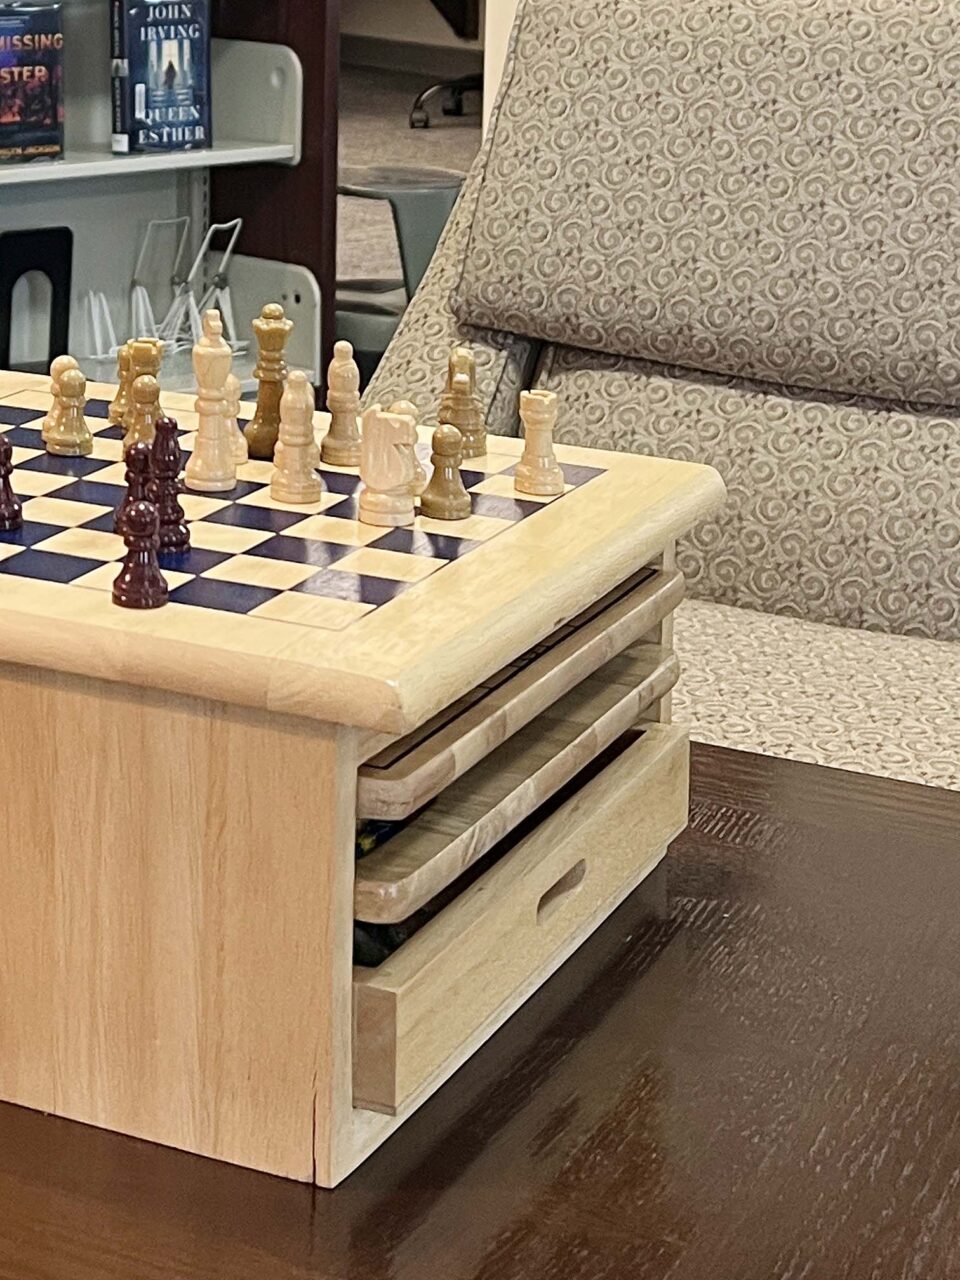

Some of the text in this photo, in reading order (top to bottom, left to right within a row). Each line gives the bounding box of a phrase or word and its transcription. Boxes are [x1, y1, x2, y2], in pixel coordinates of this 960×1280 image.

[146, 3, 193, 22] JOHN
[140, 23, 200, 41] IRVING
[143, 104, 201, 126] QUEEN
[138, 125, 206, 145] ESTHER
